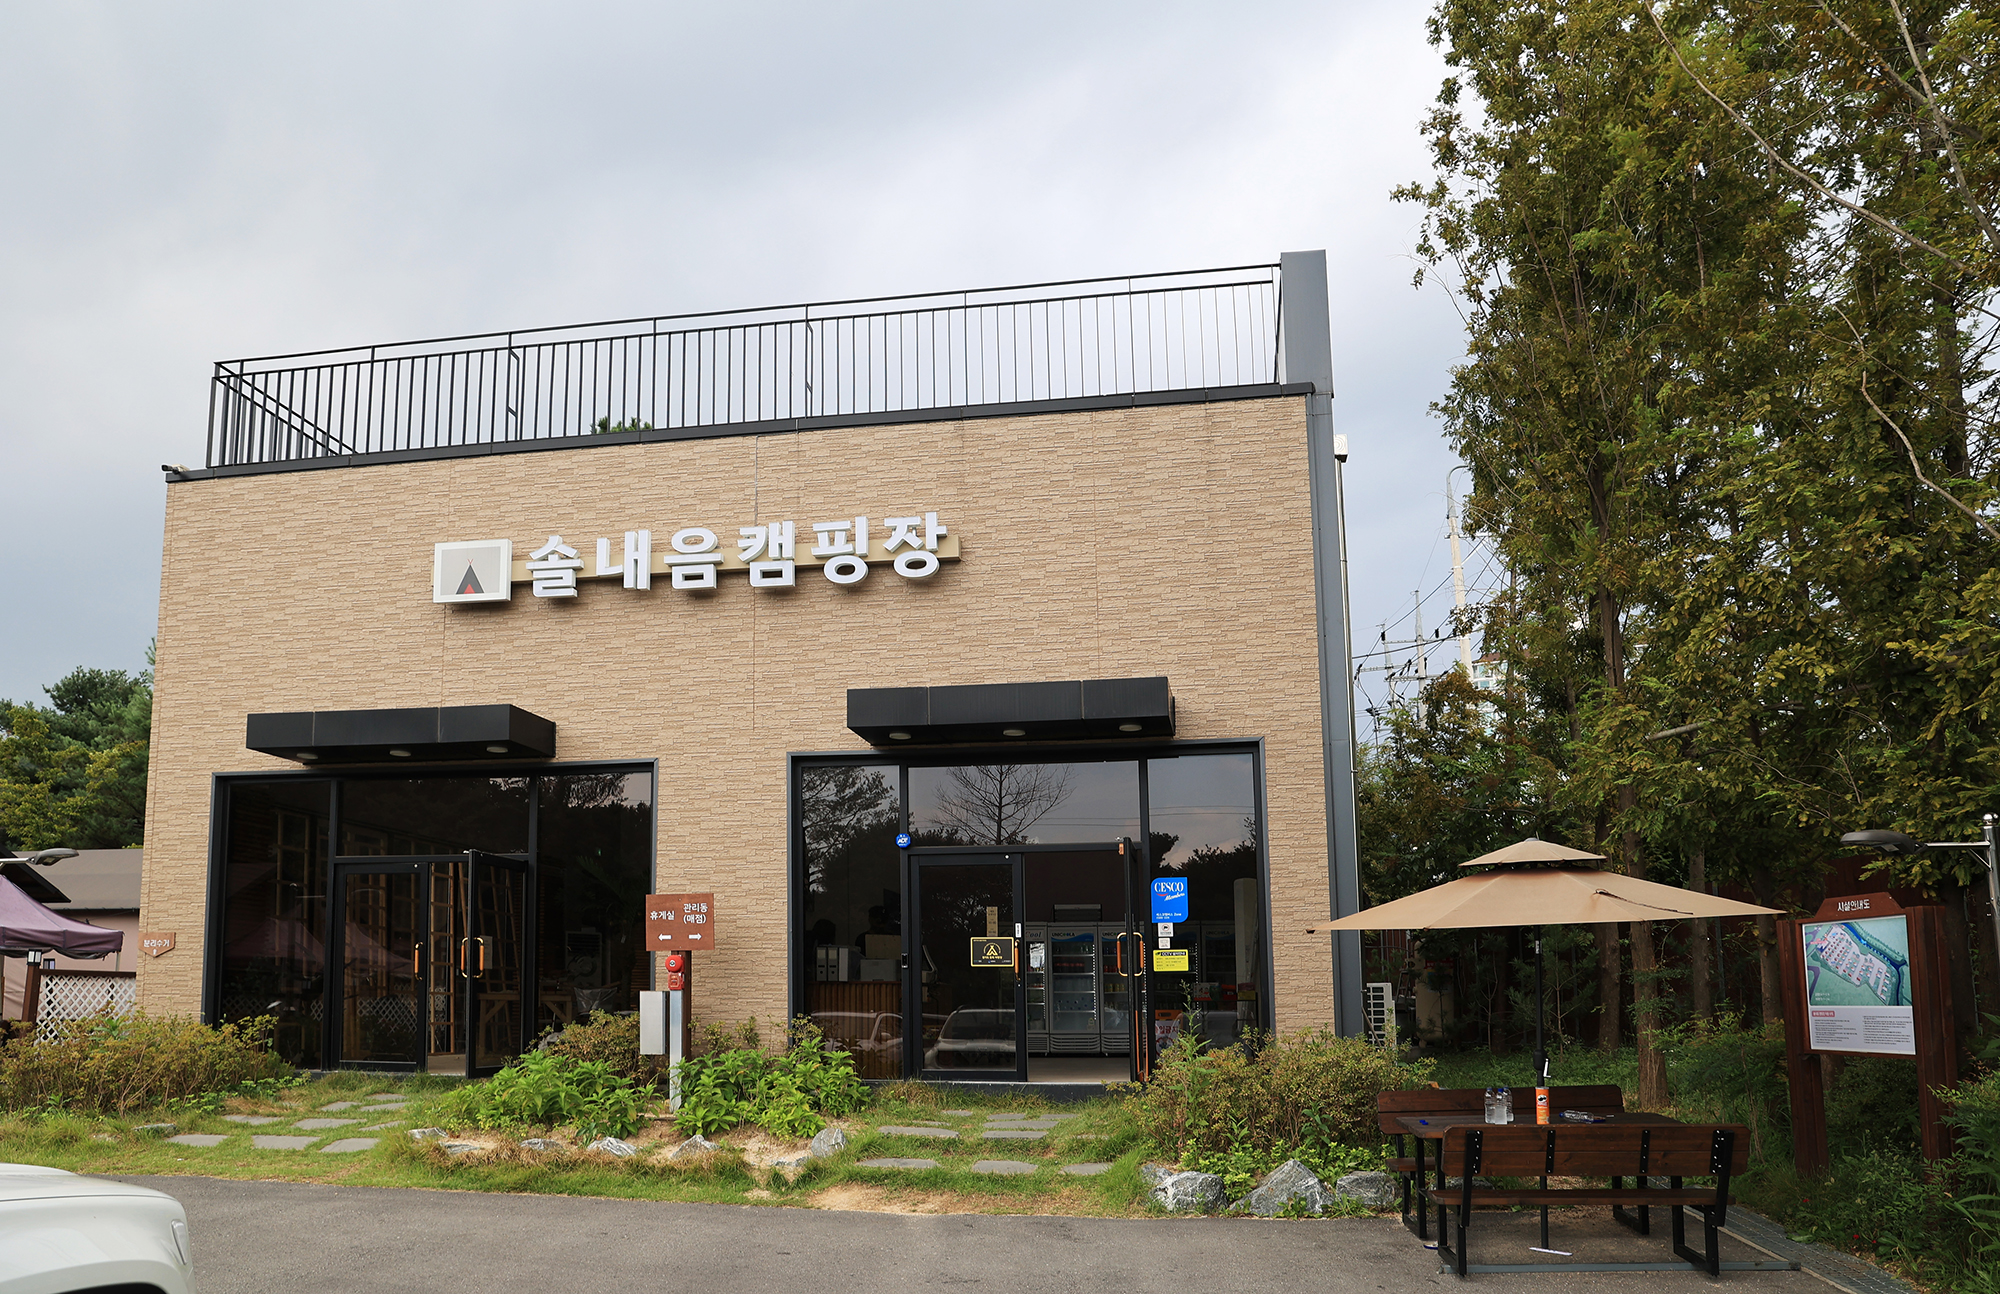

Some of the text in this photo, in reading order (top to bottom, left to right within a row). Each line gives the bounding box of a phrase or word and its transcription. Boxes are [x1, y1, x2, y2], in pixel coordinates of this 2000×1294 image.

[526, 512, 947, 597] 솔내음캠핑장
[1154, 881, 1184, 892] CESCO
[683, 903, 708, 913] 관리동
[1837, 899, 1870, 911] 시설안내도
[650, 911, 675, 920] 휴게실
[683, 914, 706, 924] (매점)
[144, 939, 170, 947] 분리수거
